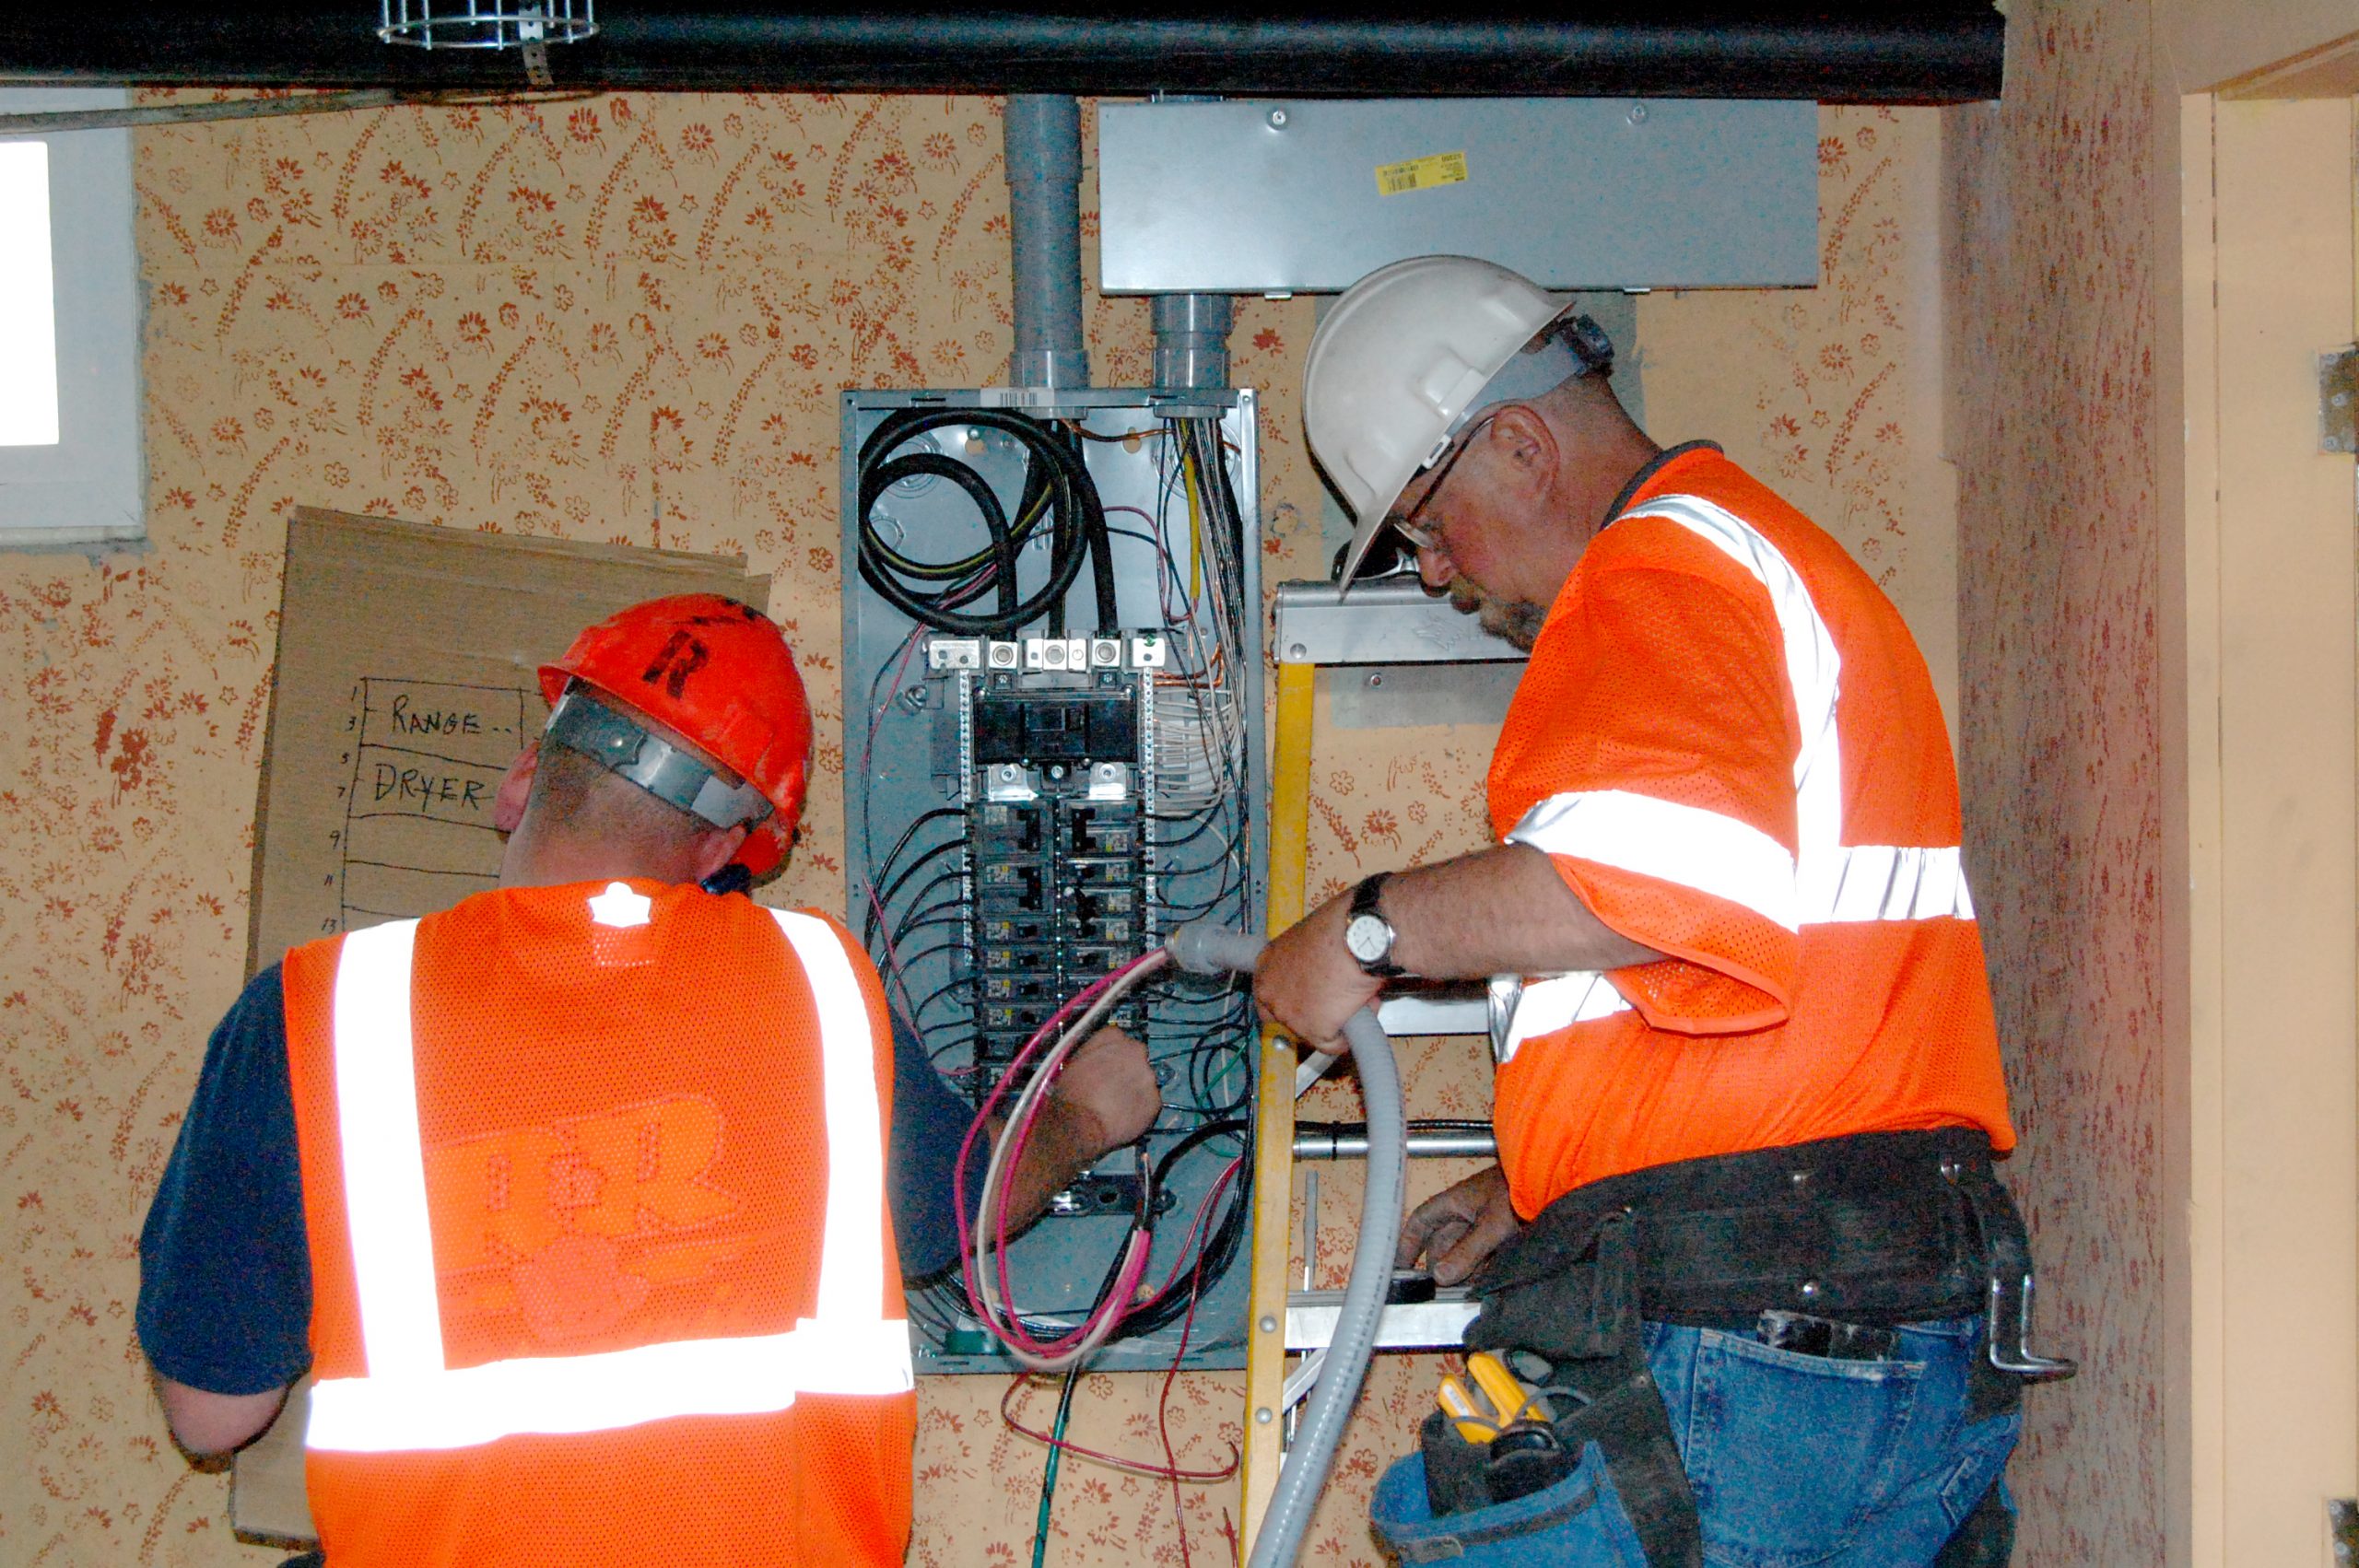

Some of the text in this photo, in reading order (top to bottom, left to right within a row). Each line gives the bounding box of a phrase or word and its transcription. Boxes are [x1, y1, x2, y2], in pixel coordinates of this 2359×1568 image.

[393, 695, 482, 734] RANGE
[336, 786, 346, 799] 7
[375, 763, 486, 812] DRYER
[329, 830, 341, 849] 9
[322, 917, 338, 935] 13
